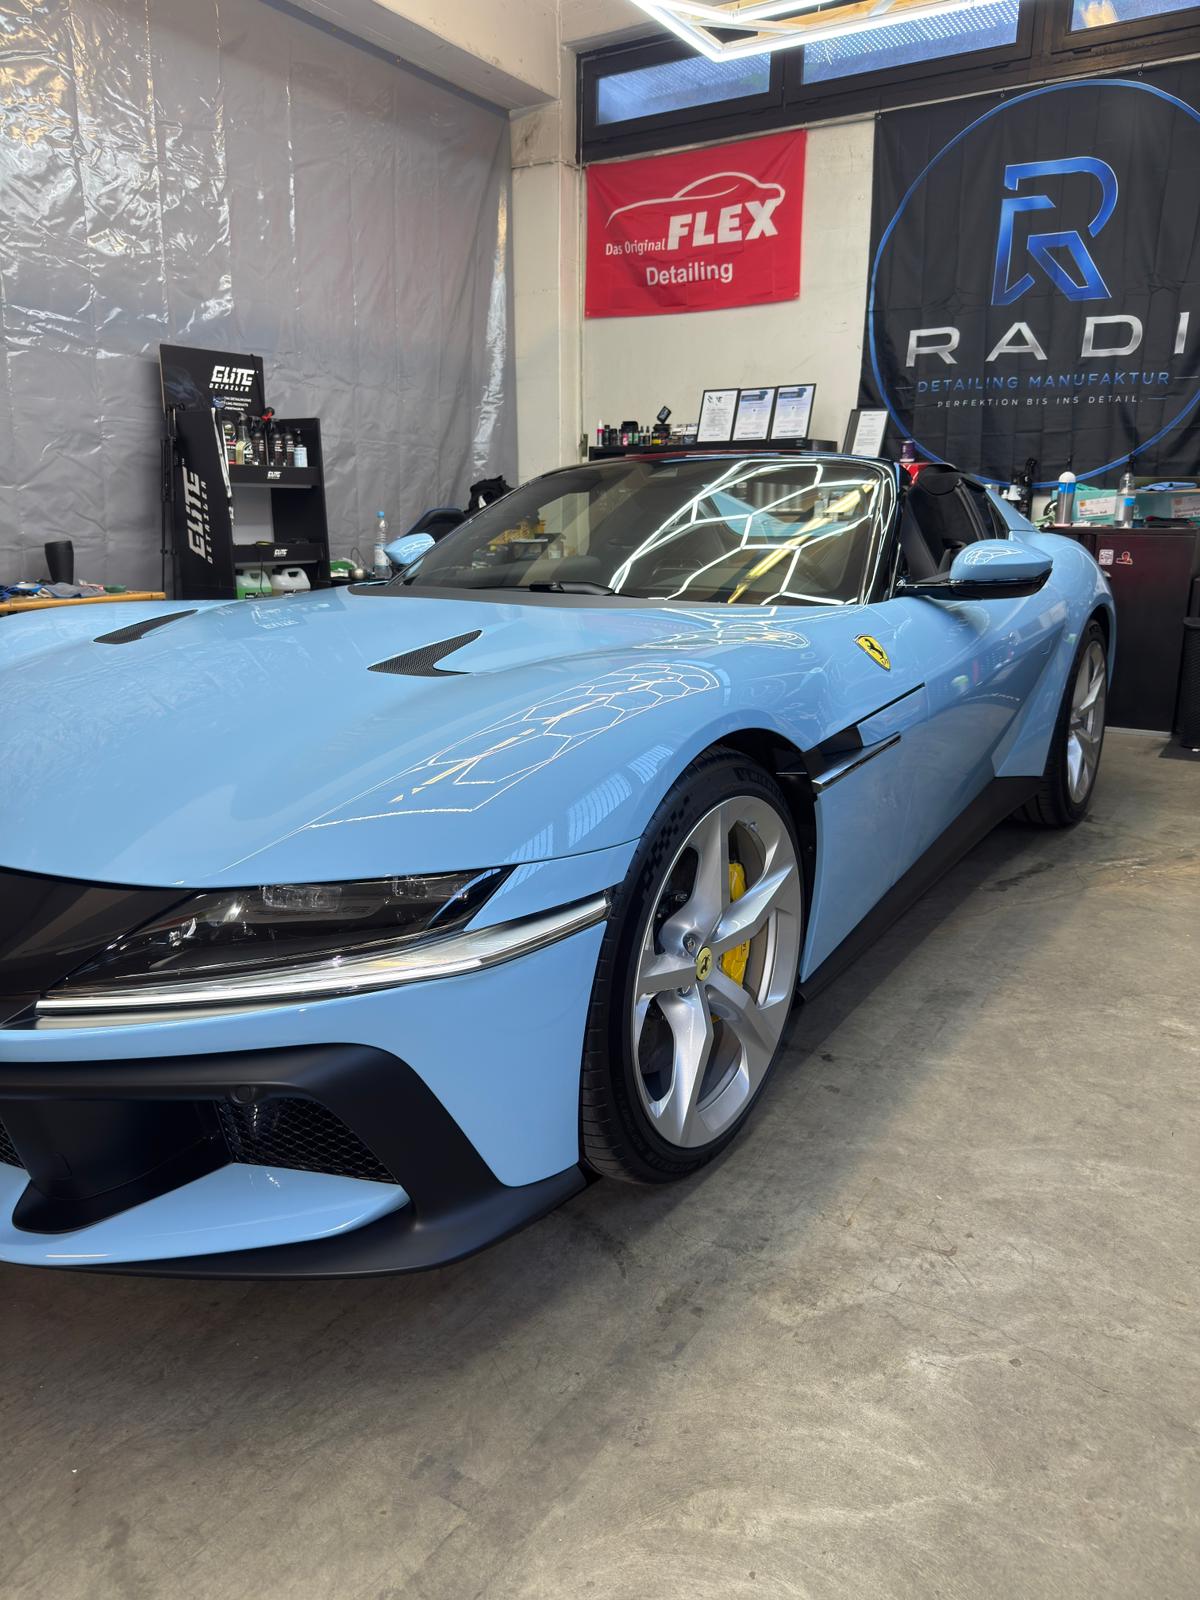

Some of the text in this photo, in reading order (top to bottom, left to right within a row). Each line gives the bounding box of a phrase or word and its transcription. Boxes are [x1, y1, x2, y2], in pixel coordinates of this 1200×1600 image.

[605, 198, 779, 255] Das Original FLEX
[646, 261, 734, 286] Detailing
[905, 311, 1190, 367] RADI
[917, 371, 1170, 393] DETAILING MANUFAKTUR
[937, 399, 1019, 408] PERFEKTION
[1026, 397, 1048, 406] BIS
[1056, 396, 1080, 405] INS
